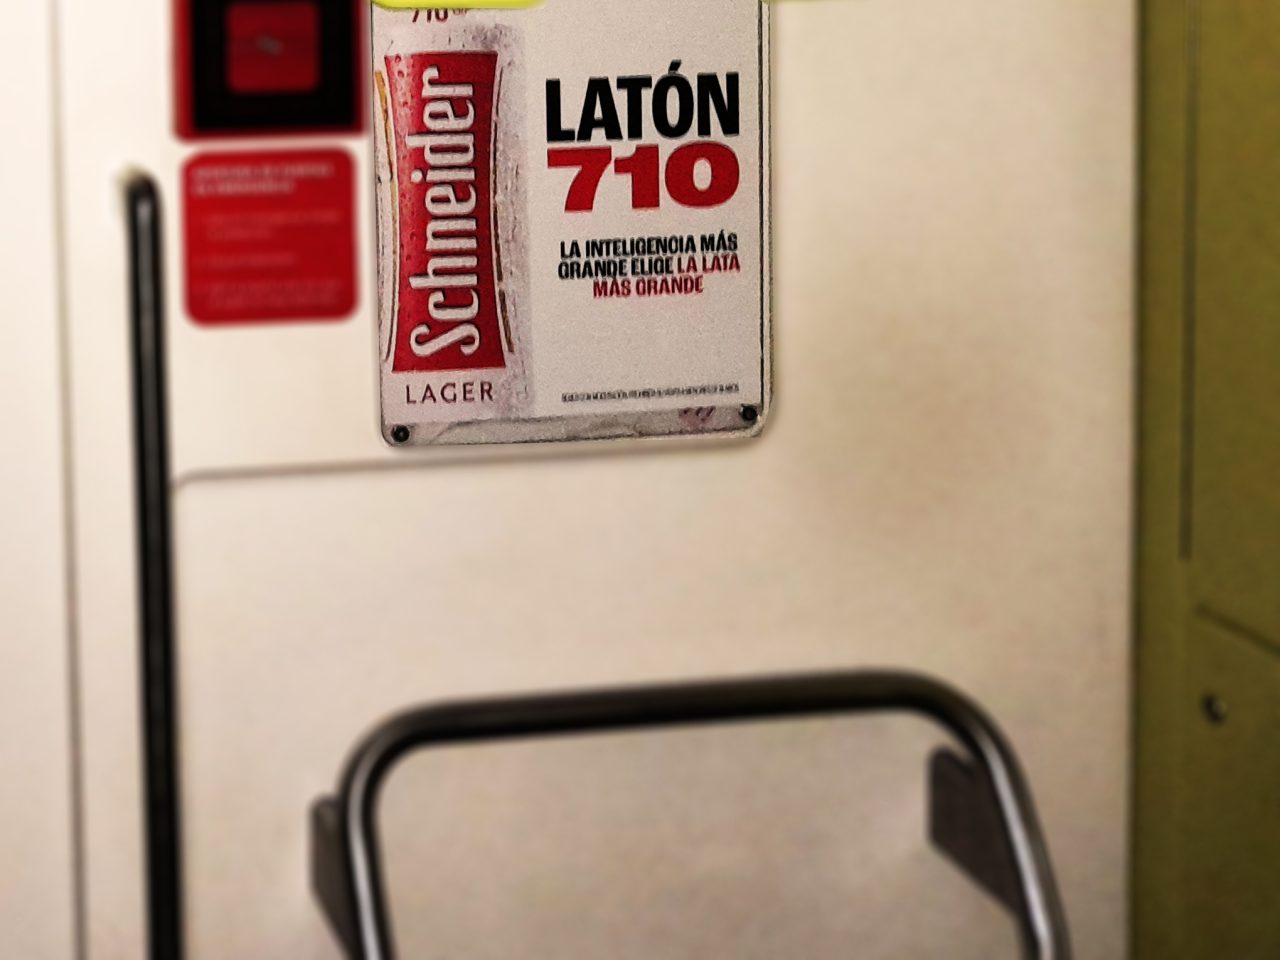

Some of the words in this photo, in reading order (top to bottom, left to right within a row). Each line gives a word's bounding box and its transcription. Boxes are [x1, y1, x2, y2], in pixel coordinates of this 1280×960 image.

[545, 59, 740, 142] LATÓN
[546, 140, 740, 212] 710
[407, 65, 480, 357] Schneider
[558, 259, 628, 279] GRANDE
[677, 255, 699, 274] LA
[702, 252, 741, 273] LATA
[560, 240, 582, 259] LA
[585, 234, 697, 257] INTELIGENCIA
[700, 229, 738, 252] MÁS
[406, 382, 494, 405] LAGER
